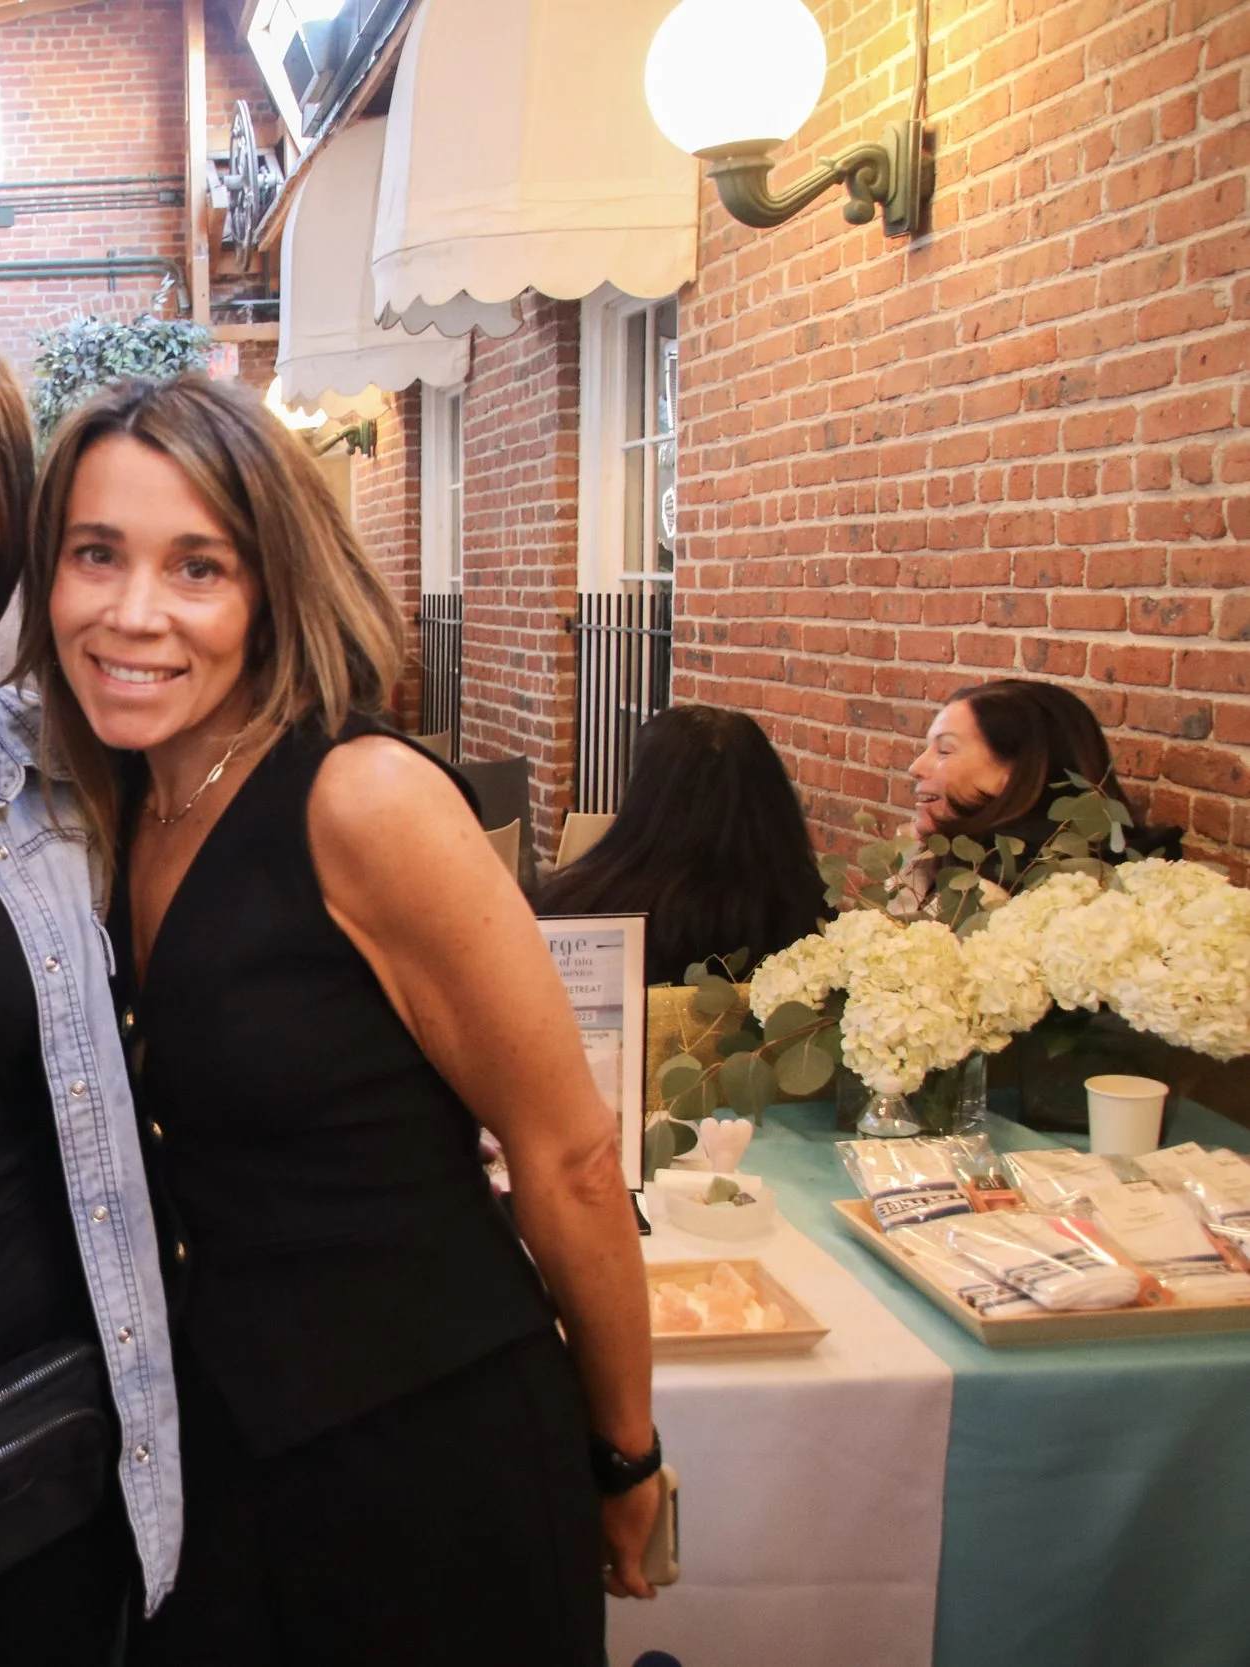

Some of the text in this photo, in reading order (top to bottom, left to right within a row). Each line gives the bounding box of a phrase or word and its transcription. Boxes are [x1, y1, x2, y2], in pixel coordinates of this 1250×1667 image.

[549, 938, 587, 956] rge
[559, 956, 571, 967] of
[574, 1012, 593, 1021] 025
